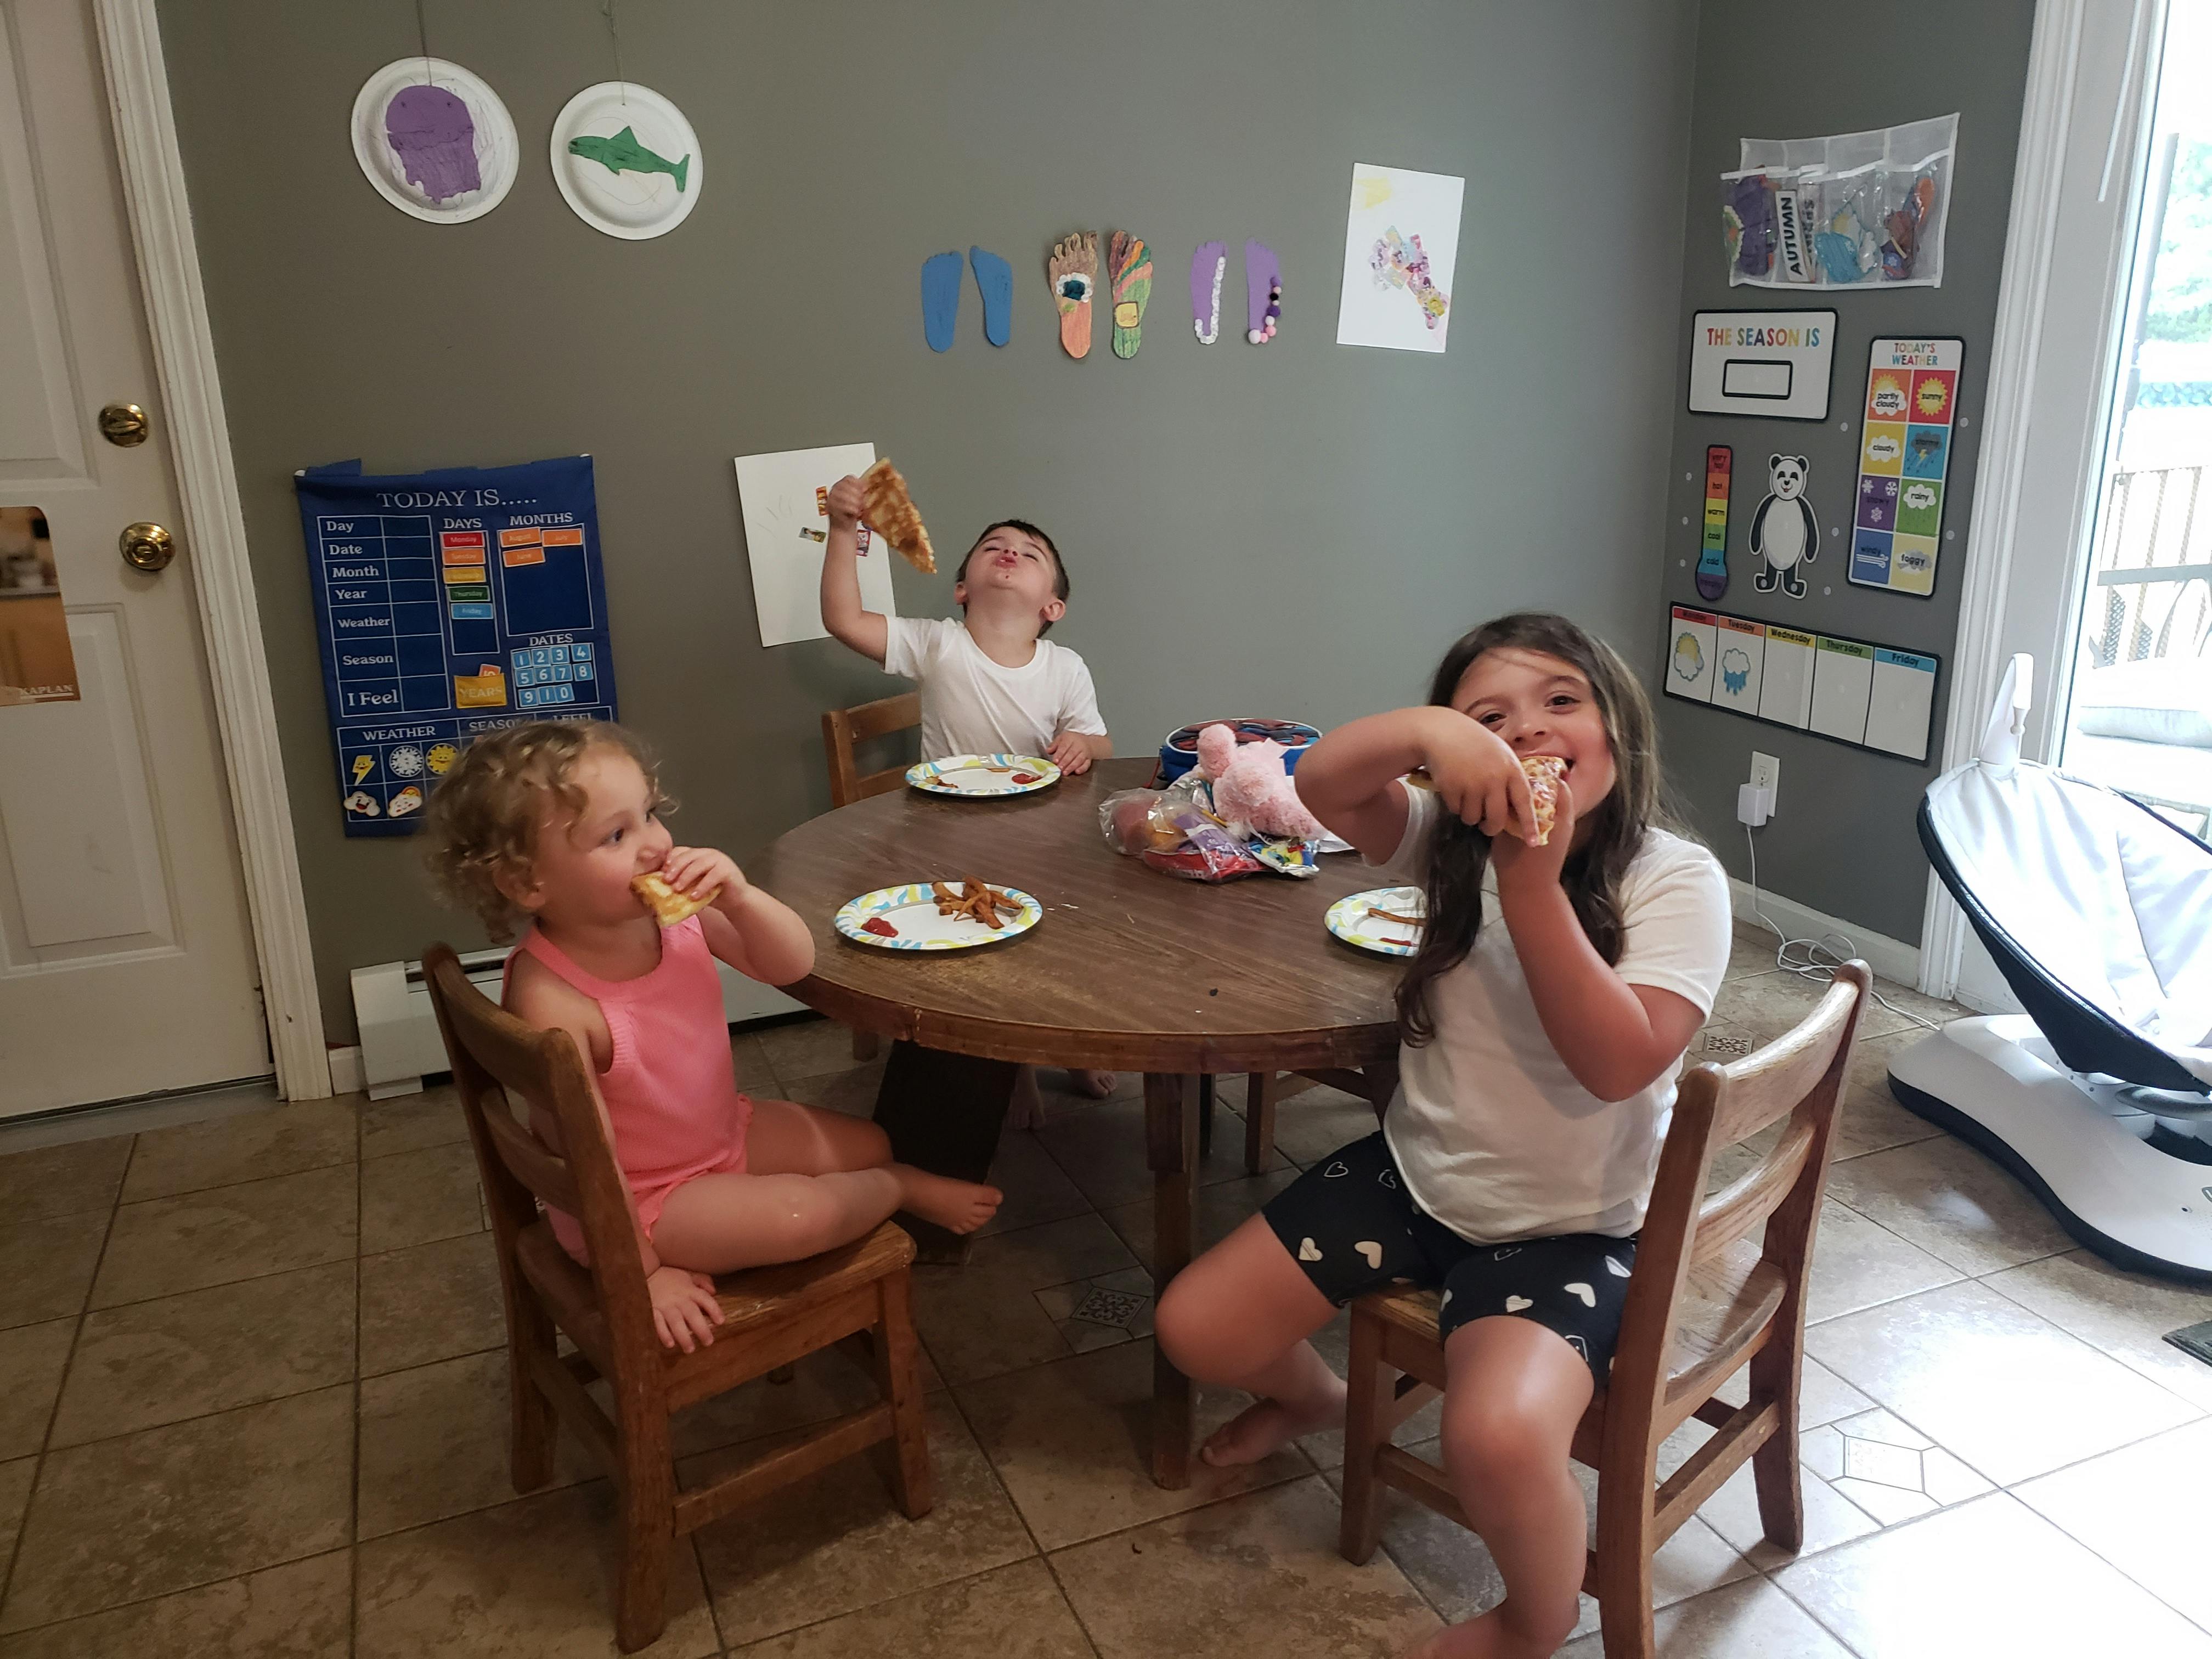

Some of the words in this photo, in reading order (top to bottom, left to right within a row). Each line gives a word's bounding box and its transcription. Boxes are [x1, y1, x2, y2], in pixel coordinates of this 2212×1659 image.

[1780, 197, 1803, 275] AUTUMN
[1707, 328, 1732, 346] THE
[1737, 327, 1800, 347] SEASON
[1805, 327, 1820, 347] IS
[1894, 342, 1936, 354] TODAY'S
[1892, 354, 1938, 366] WEATHER
[1877, 393, 1899, 402] partly
[1921, 393, 1943, 402] sunny
[1876, 401, 1899, 409] cloudy
[1873, 444, 1895, 453] cloudy
[376, 489, 467, 508] TODAY
[1910, 492, 1929, 503] rainy
[443, 518, 483, 529] DAYS
[509, 512, 574, 526] MONTHS
[325, 521, 354, 533] Day
[450, 536, 477, 544] Monday
[1707, 532, 1721, 540] cool
[329, 544, 363, 555] Date
[1706, 557, 1720, 566] cold
[1901, 554, 1926, 567] foggy
[332, 565, 380, 578] Month
[335, 589, 368, 600] Year
[337, 617, 391, 628] Weather
[1728, 619, 1756, 634] Tuesday
[529, 633, 574, 646] DATES
[1771, 628, 1812, 646] Wednesday
[1827, 639, 1863, 656] Thursday
[342, 654, 394, 665] Season
[519, 654, 523, 665] 1
[537, 651, 545, 663] 2
[556, 649, 563, 661] 3
[577, 646, 586, 658] 4
[1891, 653, 1920, 668] Friday
[521, 673, 529, 684] 5
[539, 669, 548, 680] 6
[558, 668, 566, 680] 7
[579, 666, 588, 678] 8
[20, 684, 75, 696] KAPLAN
[459, 686, 504, 699] YEARS
[347, 692, 356, 706] I
[358, 689, 399, 706] Feel
[524, 691, 533, 703] 9
[469, 719, 516, 731] SEASO
[362, 726, 437, 741] WEATHER
